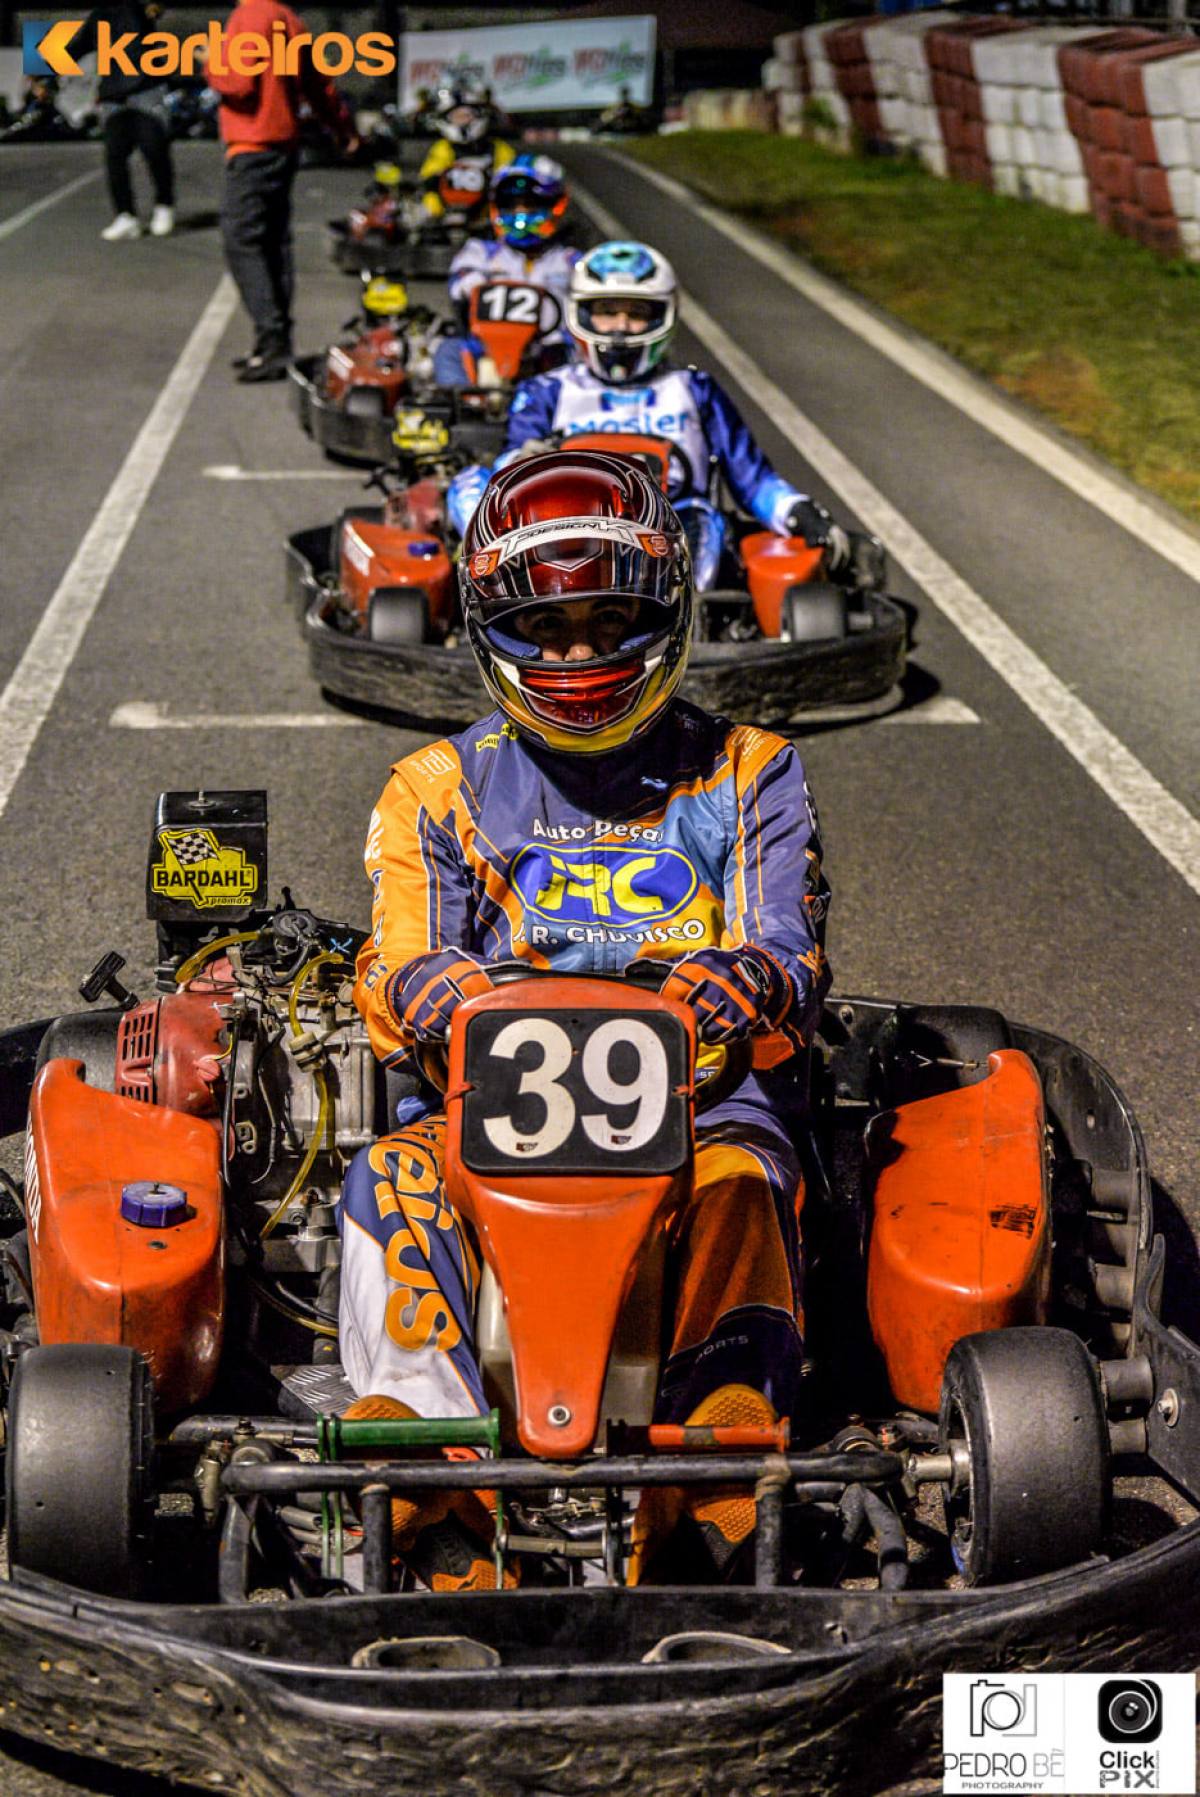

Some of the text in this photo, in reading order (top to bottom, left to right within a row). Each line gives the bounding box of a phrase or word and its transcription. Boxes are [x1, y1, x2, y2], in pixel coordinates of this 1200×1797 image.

[482, 285, 540, 323] 12
[533, 818, 586, 841] Auto
[156, 870, 251, 888] BARDAHL
[532, 926, 559, 945] R.
[482, 1017, 669, 1159] 39
